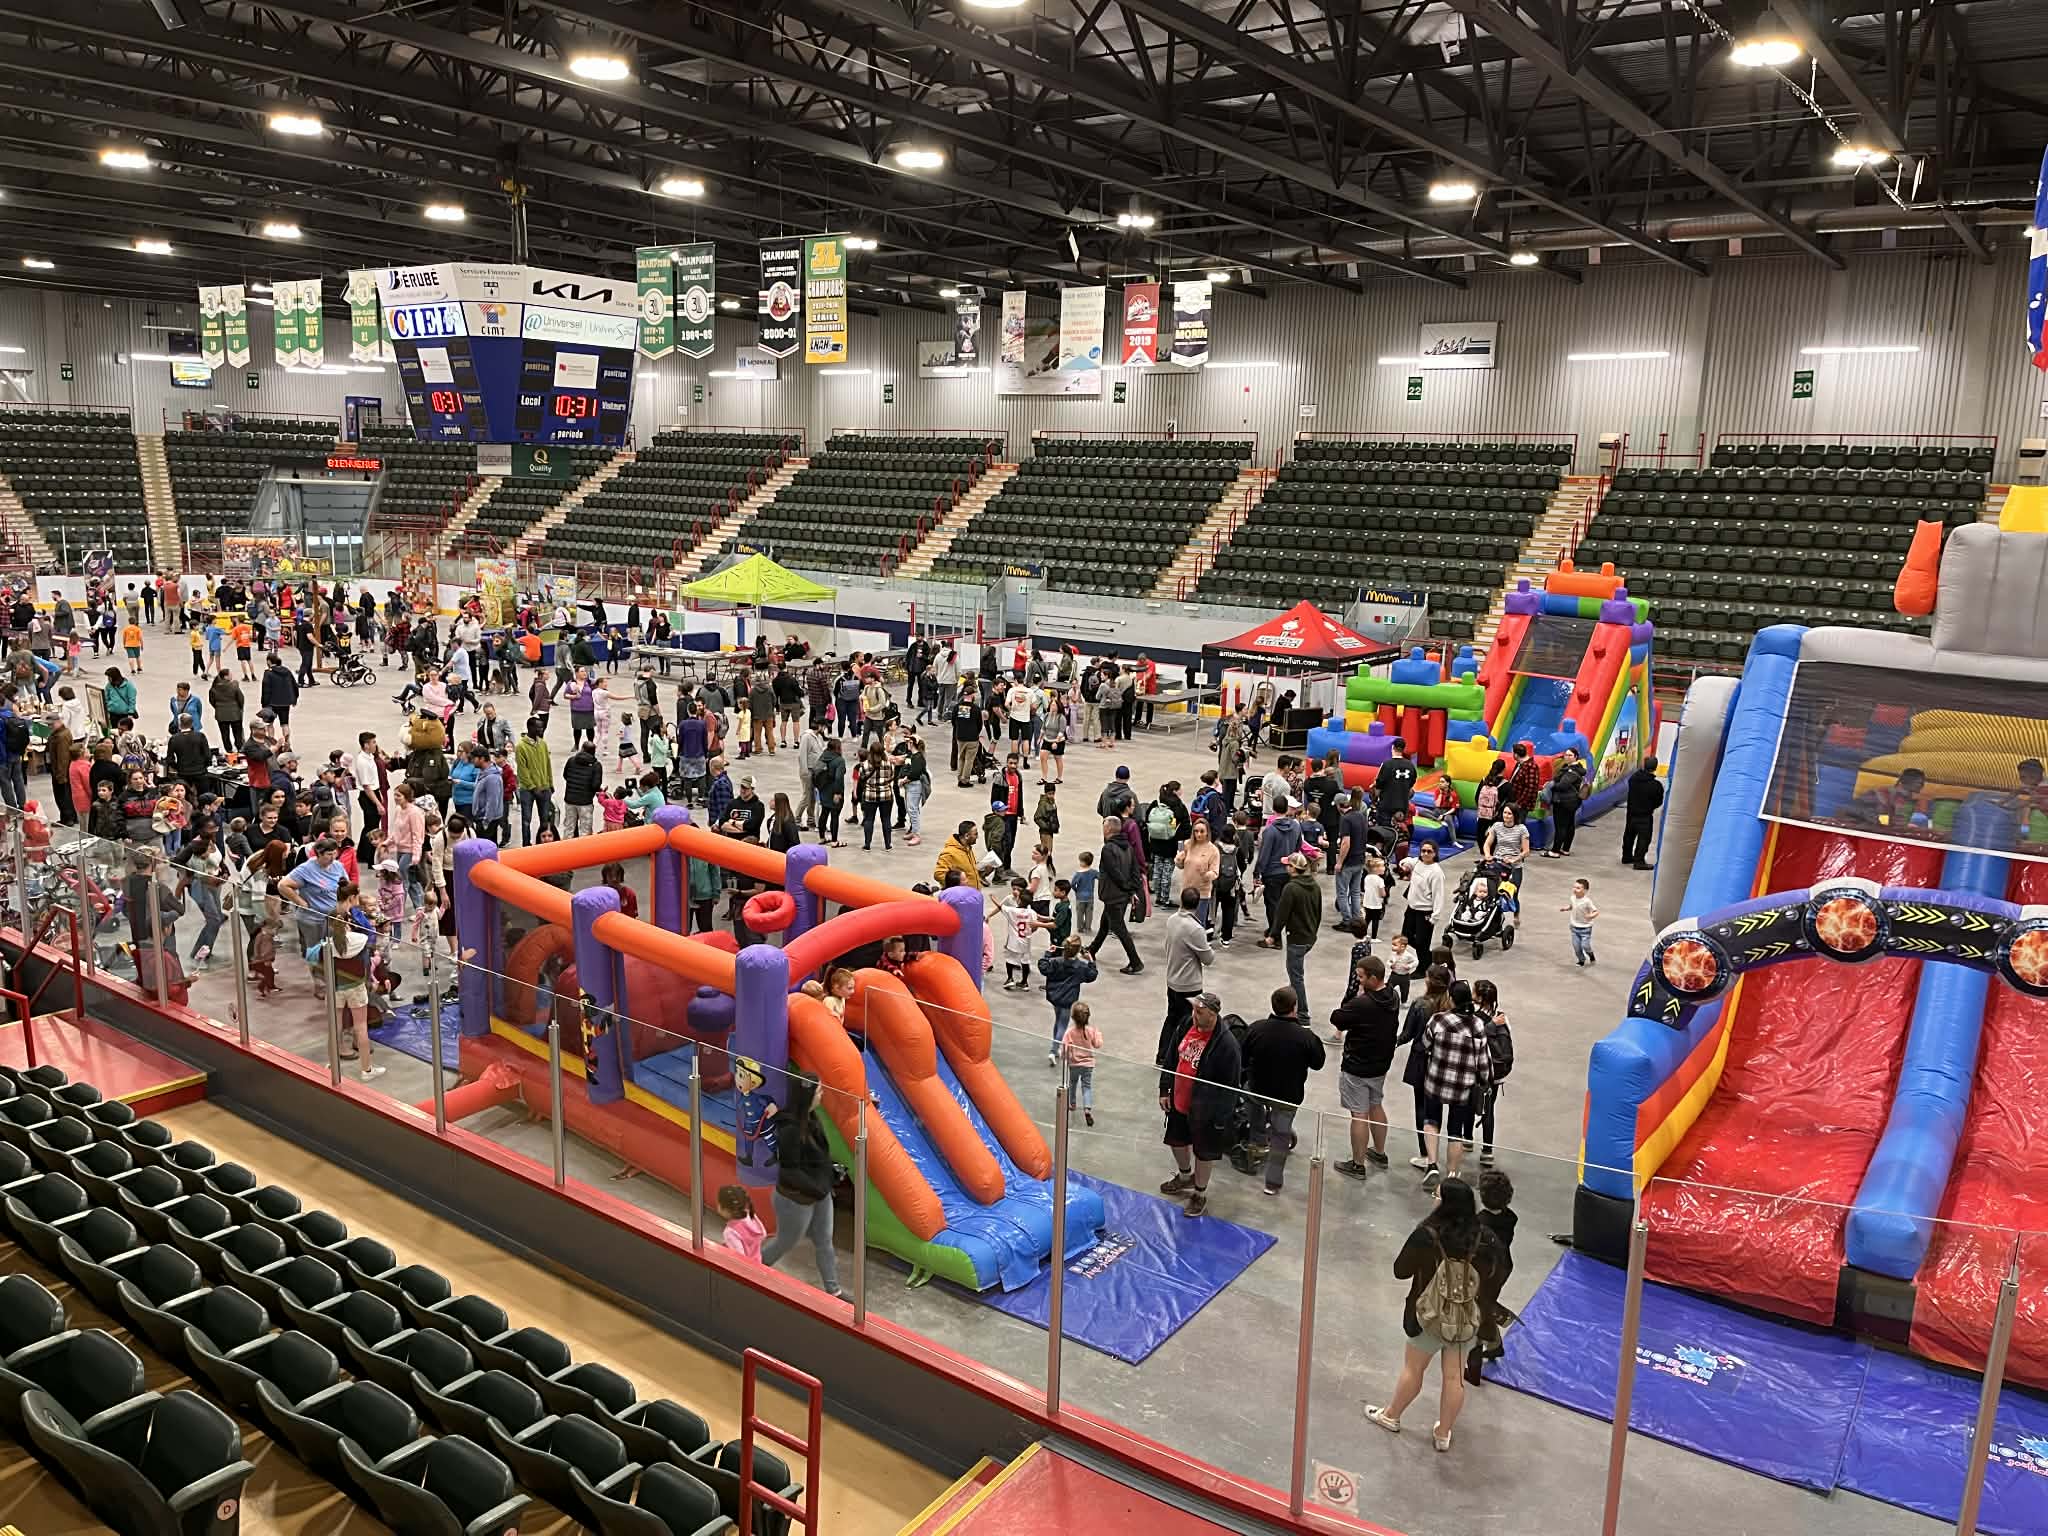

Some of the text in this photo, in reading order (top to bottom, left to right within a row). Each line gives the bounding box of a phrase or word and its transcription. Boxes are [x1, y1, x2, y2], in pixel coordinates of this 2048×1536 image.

[679, 255, 714, 266] CHAMPIONS
[762, 250, 800, 261] CHAMPIONS
[488, 267, 521, 276] Financiers
[532, 279, 613, 304] KIA
[808, 280, 844, 299] CHAMPIONS
[393, 306, 457, 338] CIEL
[543, 315, 583, 329] Universel
[481, 325, 505, 336] CIMT
[1175, 329, 1208, 340] MORIN
[1408, 386, 1422, 396] 22
[1794, 382, 1812, 393] 20
[1114, 390, 1126, 400] 24
[520, 395, 542, 407] Local
[555, 395, 598, 417] 10:31
[327, 459, 380, 469] BIENVENUE
[529, 463, 553, 473] Quality
